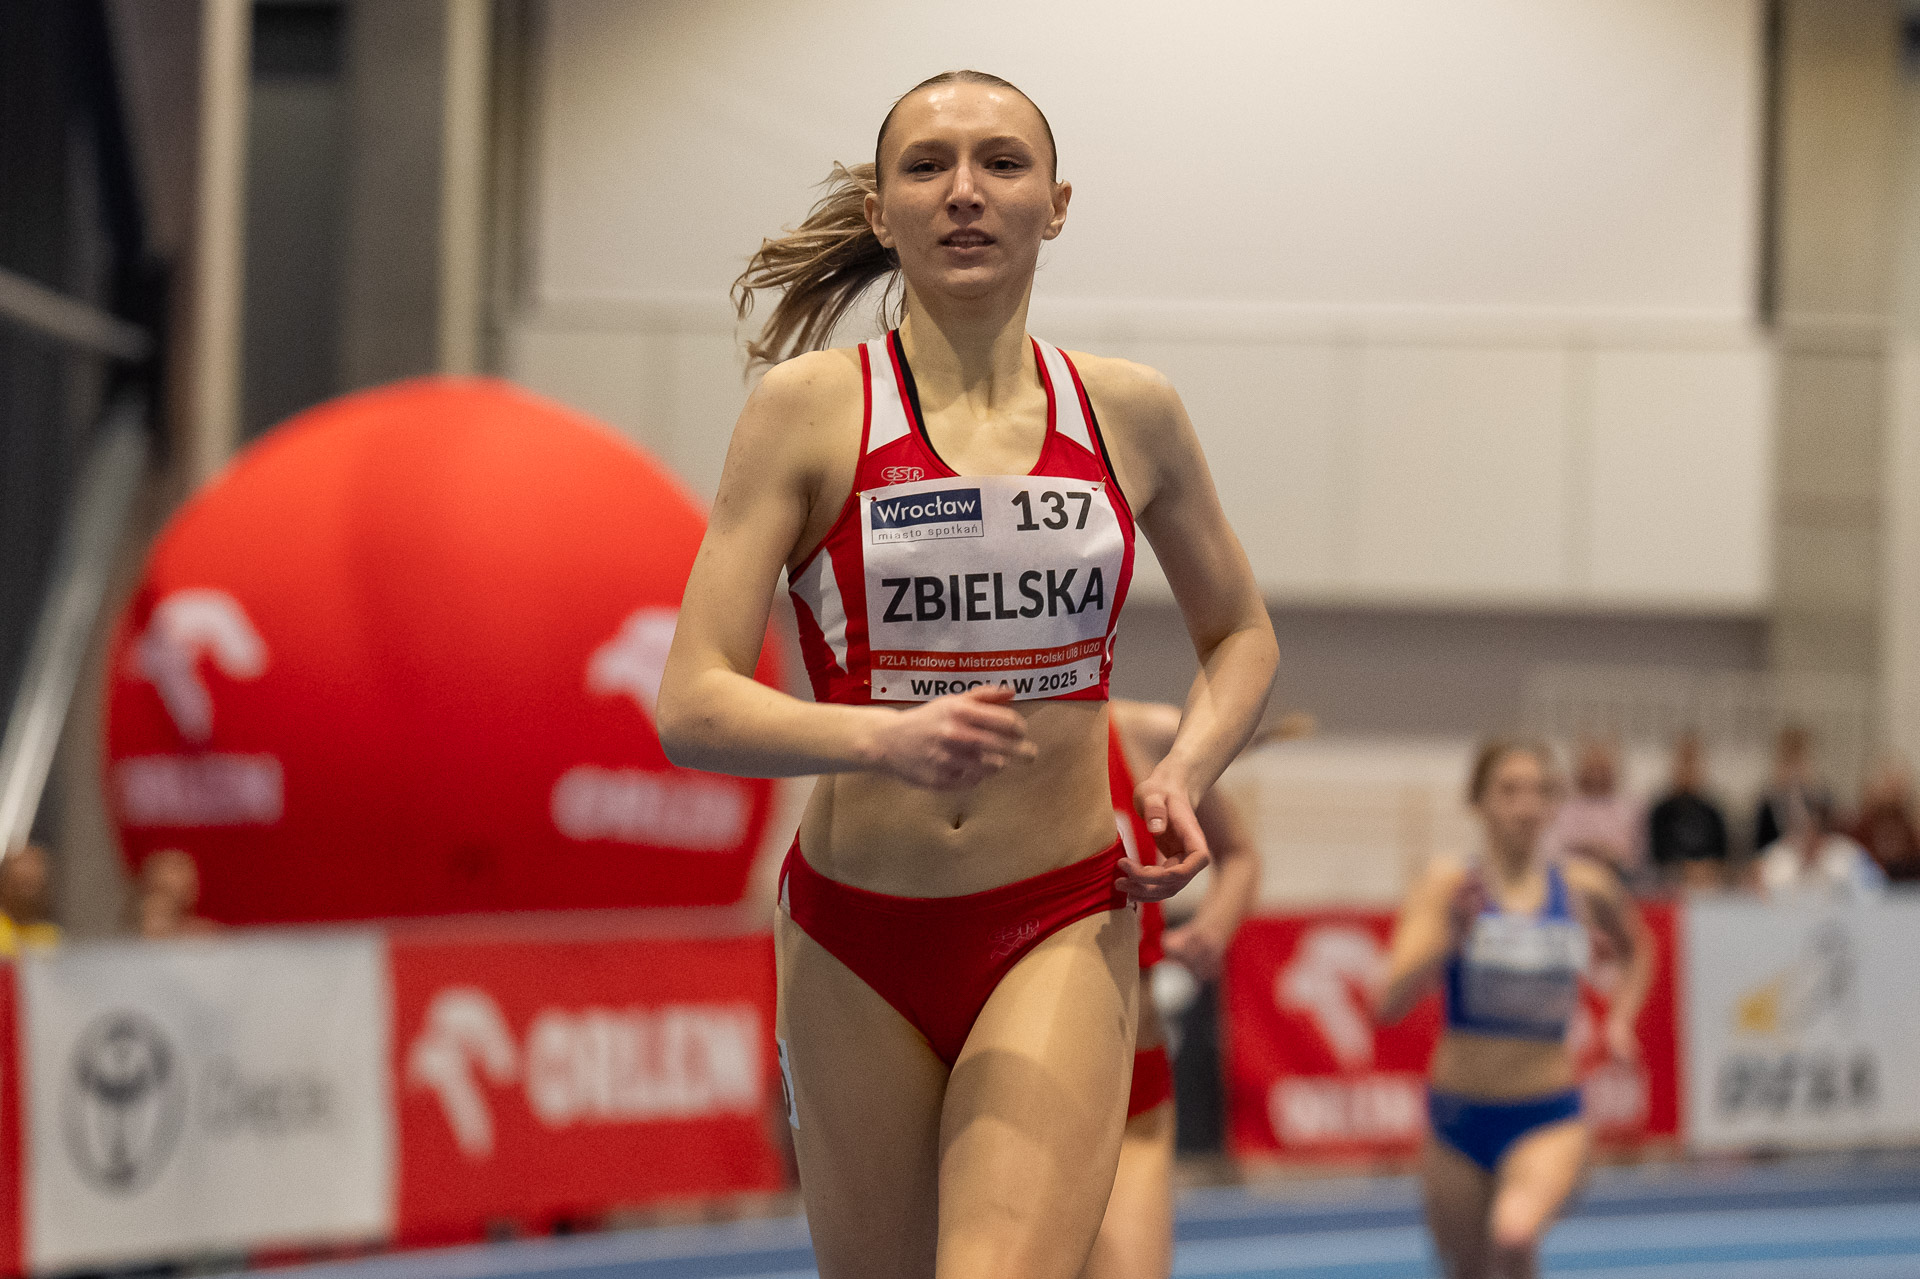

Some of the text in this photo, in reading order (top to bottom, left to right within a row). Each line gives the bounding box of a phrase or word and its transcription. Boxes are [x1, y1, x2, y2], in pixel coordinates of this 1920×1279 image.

[877, 496, 976, 523] Wrocław
[1011, 490, 1092, 531] 137
[878, 524, 979, 541] miasto spotkań
[881, 566, 1104, 623] ZBIELSKA
[879, 655, 907, 666] PZLA
[910, 656, 956, 668] Halowe
[958, 656, 1033, 668] Mistrzostwa
[1035, 652, 1065, 664] Polski
[1084, 641, 1100, 654] U20
[911, 669, 1078, 695] WROAW 2025
